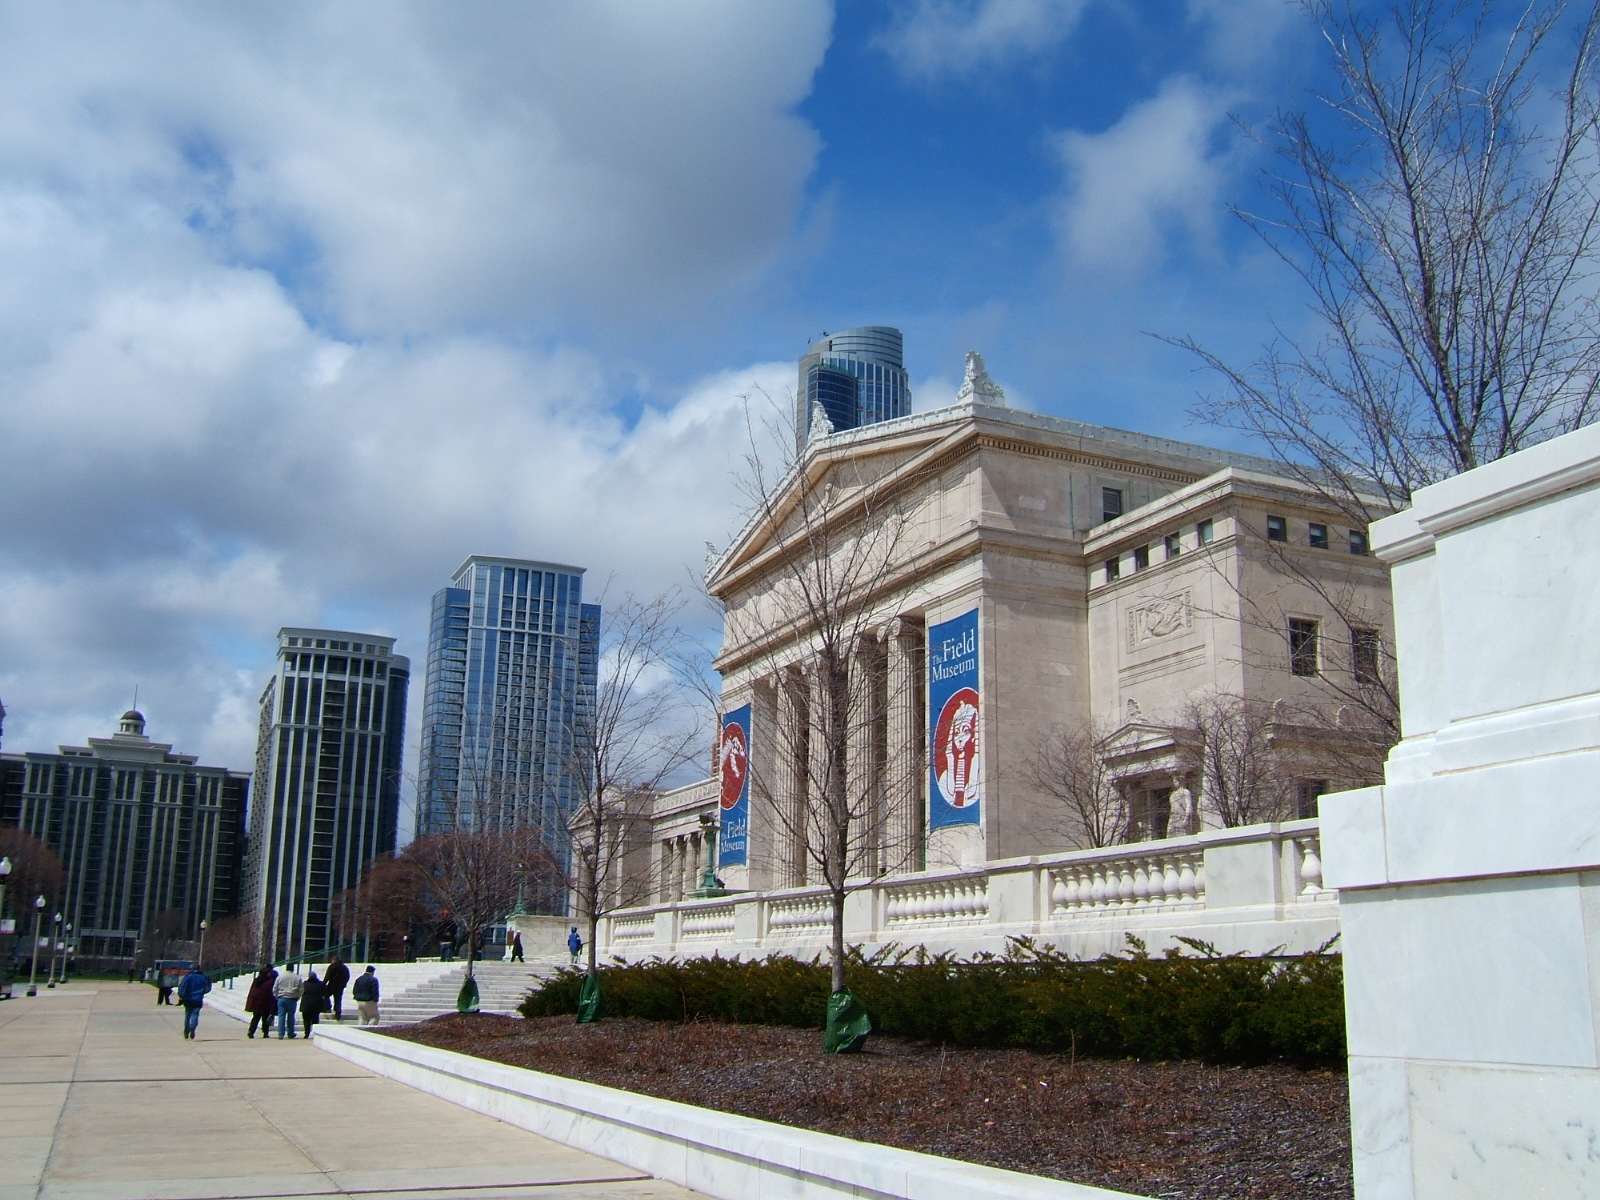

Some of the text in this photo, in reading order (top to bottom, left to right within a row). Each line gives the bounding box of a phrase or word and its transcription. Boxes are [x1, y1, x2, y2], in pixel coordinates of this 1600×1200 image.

[932, 628, 975, 665] The Field
[932, 658, 975, 683] Museum
[727, 818, 745, 838] Field
[720, 840, 745, 855] Museum
